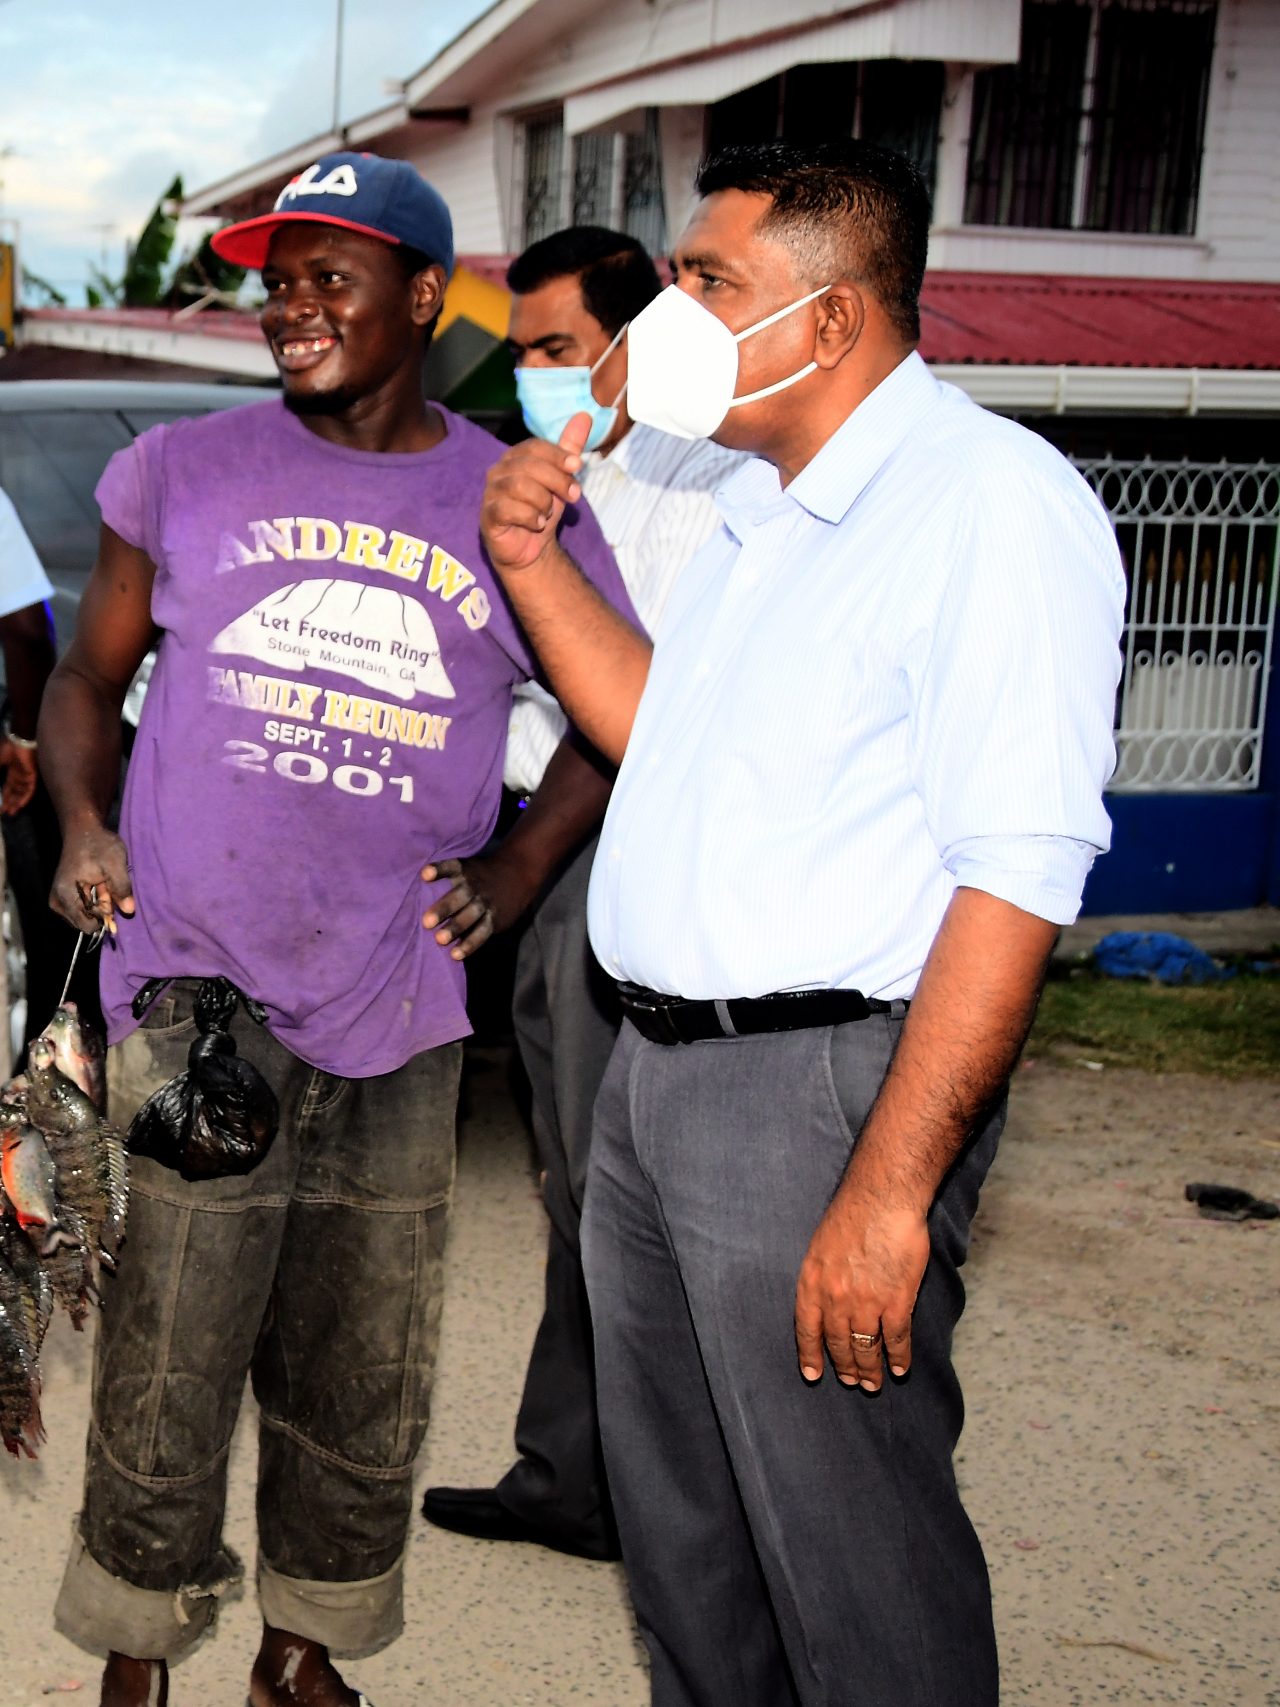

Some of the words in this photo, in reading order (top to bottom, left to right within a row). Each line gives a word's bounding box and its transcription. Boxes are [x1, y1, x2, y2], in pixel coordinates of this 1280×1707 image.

[214, 516, 491, 630] ANDREWS
[267, 636, 310, 657] Stone
[319, 649, 390, 678] Mountain,
[399, 666, 416, 682] GA
[298, 620, 381, 653] Freedom
[207, 666, 322, 721] FAMILY
[321, 688, 452, 751] REUNION
[221, 738, 414, 803] 2001
[263, 719, 329, 753] SEPT.
[342, 737, 352, 758] 1
[379, 746, 393, 767] 2
